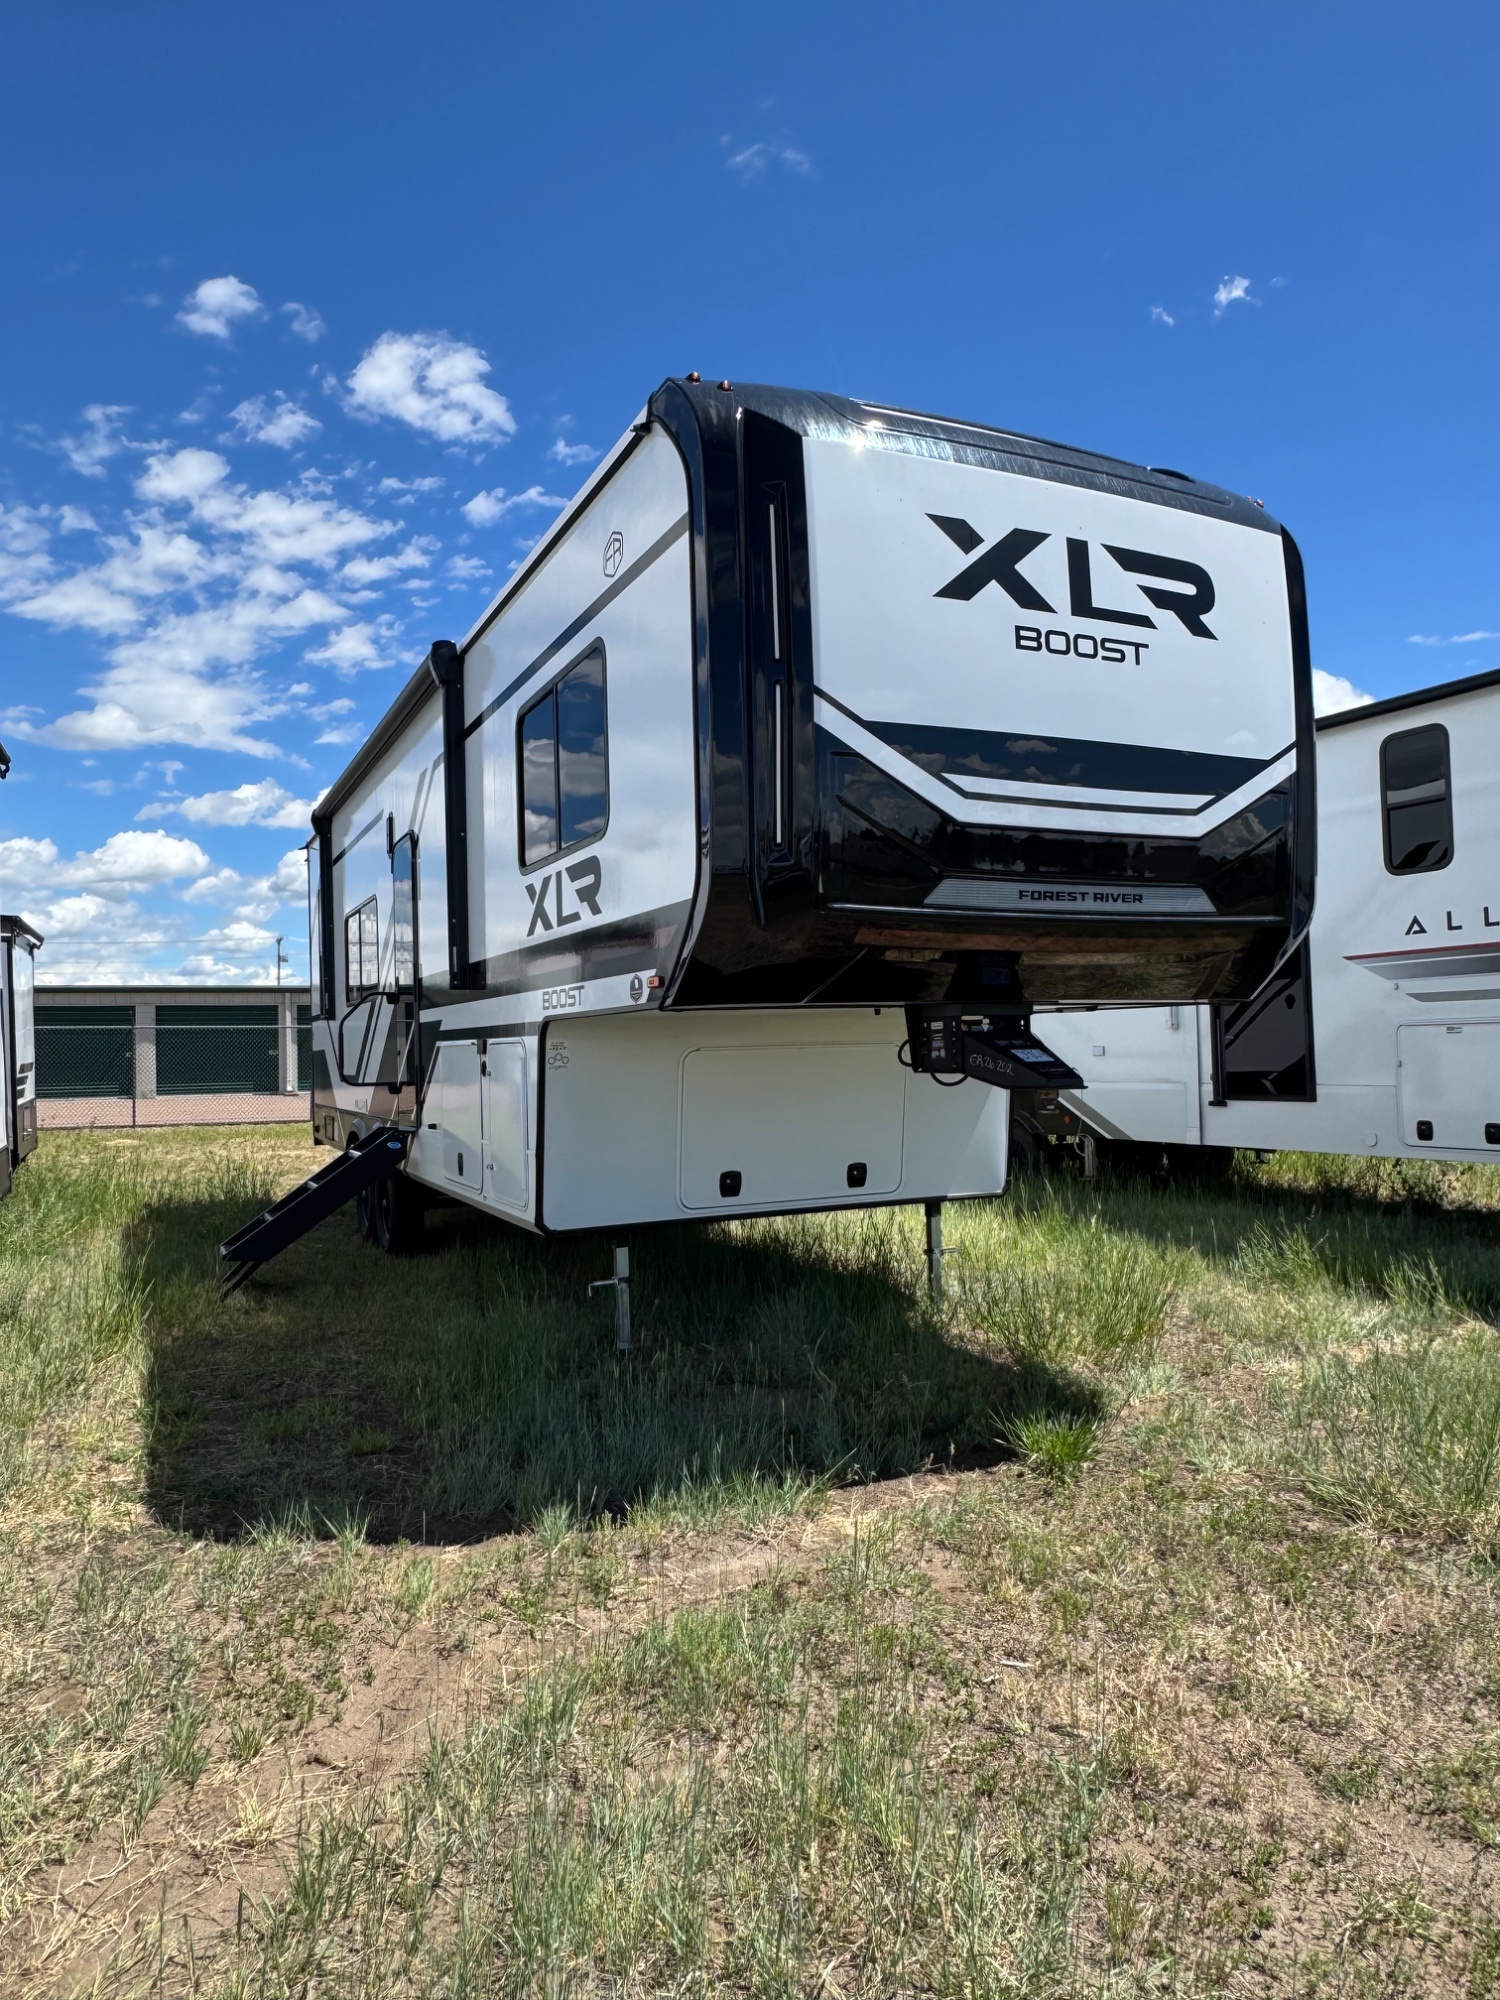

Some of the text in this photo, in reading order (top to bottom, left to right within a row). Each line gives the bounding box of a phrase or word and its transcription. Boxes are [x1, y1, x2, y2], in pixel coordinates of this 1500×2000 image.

[925, 512, 1219, 641] XLR
[1014, 624, 1149, 666] BOOST
[524, 854, 603, 938] XLR
[1018, 889, 1143, 904] FOREST RIVER
[542, 984, 585, 1011] BOOST
